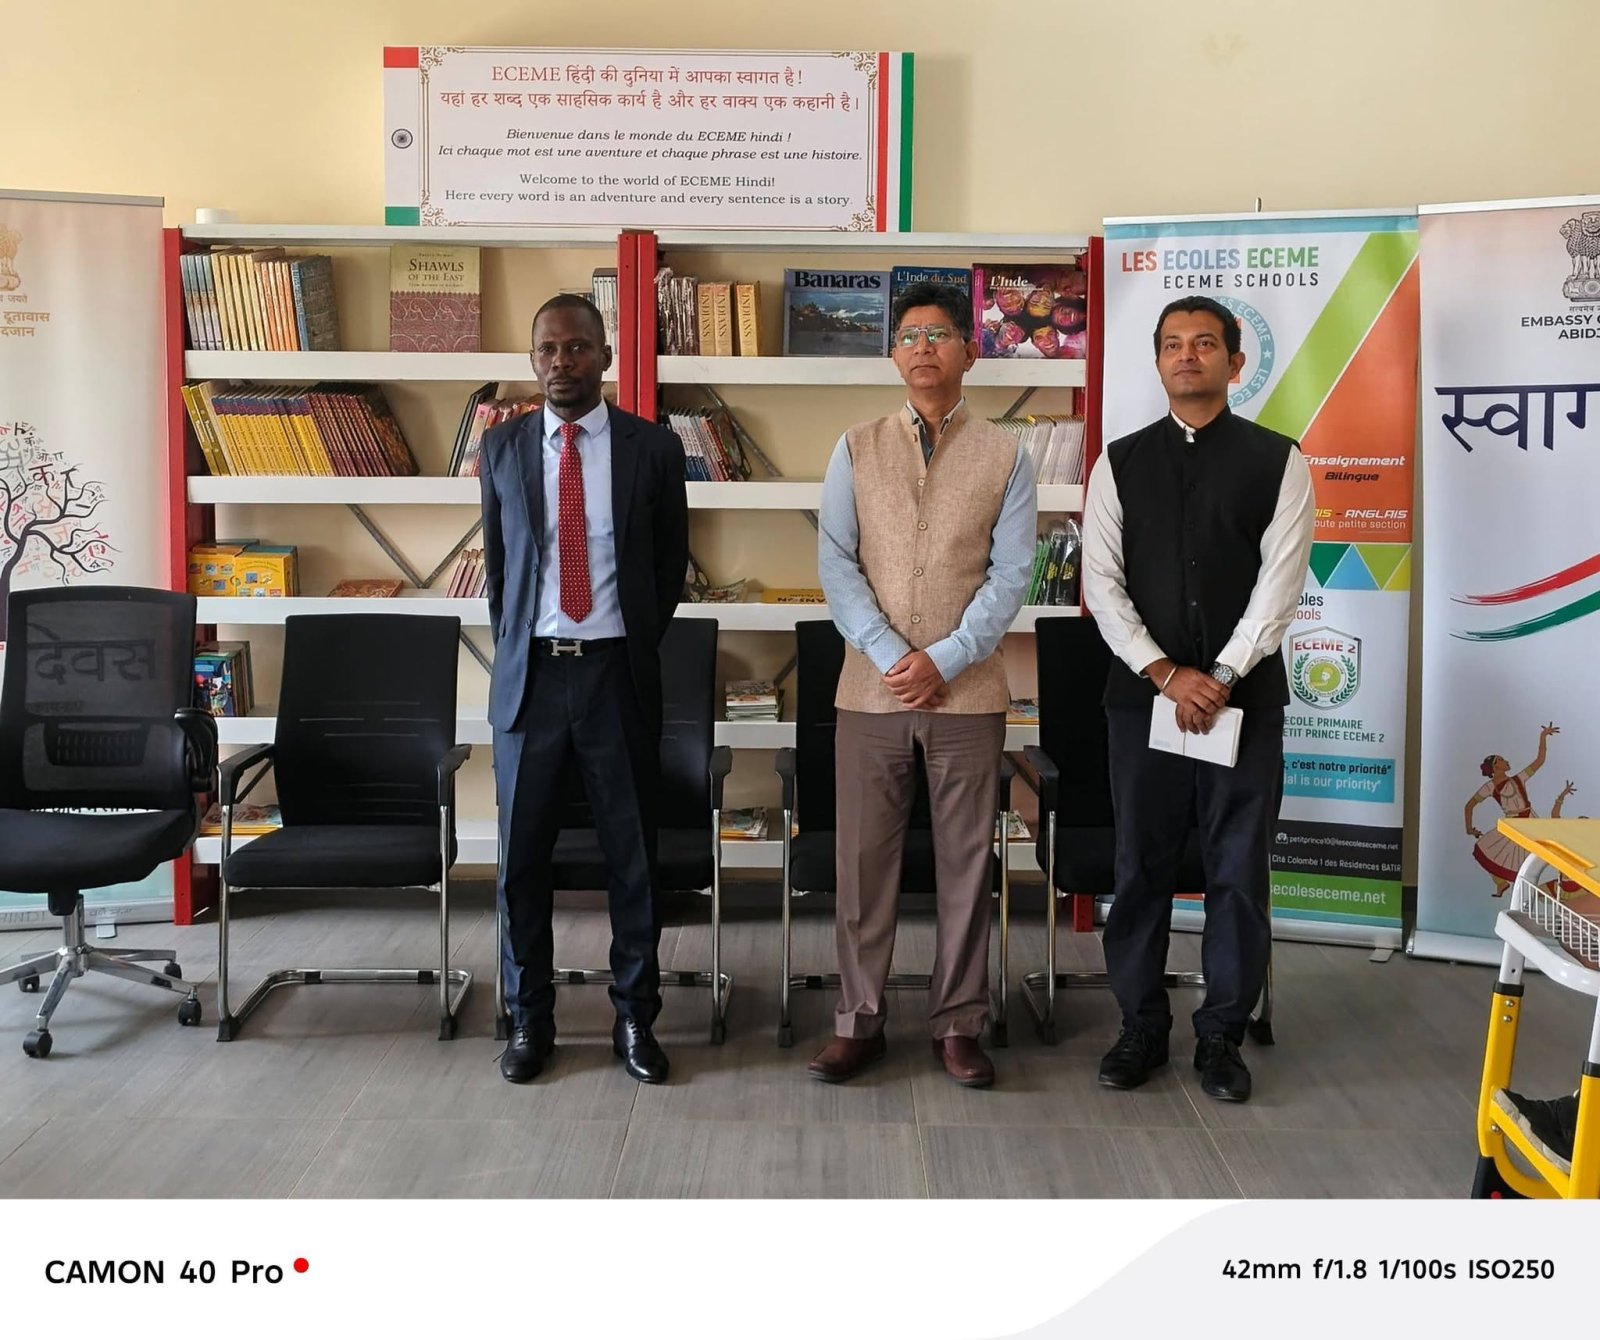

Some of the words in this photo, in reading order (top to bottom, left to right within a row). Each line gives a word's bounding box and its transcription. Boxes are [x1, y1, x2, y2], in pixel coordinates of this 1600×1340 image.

[492, 67, 561, 81] ECEME
[567, 65, 596, 84] हिंदी
[600, 65, 618, 82] की
[623, 65, 664, 87] दुनिया
[669, 66, 679, 83] में
[686, 70, 733, 84] आपका
[737, 71, 780, 84] स्वागत
[471, 93, 488, 107] हर
[494, 93, 523, 108] शब्द
[528, 93, 550, 108] एक
[557, 90, 612, 109] साहसिक
[618, 90, 646, 107] कार्य
[653, 89, 662, 110] है
[668, 90, 694, 109] और
[700, 96, 717, 110] हर
[723, 96, 757, 109] वाक्य
[764, 97, 787, 111] एक
[793, 93, 835, 111] कहानी
[506, 129, 574, 140] Bienvenue
[578, 130, 610, 140] dans
[615, 130, 625, 141] le
[629, 131, 673, 141] monde
[677, 131, 693, 141] du
[698, 132, 746, 142] ECEME
[439, 146, 453, 156] Ici
[457, 146, 503, 158] chaque
[507, 147, 530, 156] mot
[535, 148, 553, 157] est
[558, 149, 582, 157] une
[585, 149, 642, 158] aventure
[646, 149, 657, 158] et
[662, 148, 708, 161] chaque
[712, 149, 756, 161] phrase
[760, 150, 779, 160] est
[784, 151, 808, 160] une
[812, 150, 862, 160] histoire.
[520, 174, 577, 185] Welcome
[582, 176, 594, 185] to
[599, 175, 620, 185] the
[624, 175, 659, 186] world
[664, 176, 677, 186] of
[681, 177, 731, 187] ECEME
[736, 177, 775, 187] Hindi!
[446, 190, 475, 201] Here
[480, 193, 514, 203] every
[518, 192, 549, 201] word
[555, 192, 565, 202] is
[570, 194, 586, 202] an
[591, 192, 656, 202] adventure
[661, 193, 685, 204] and
[690, 195, 724, 206] every
[728, 194, 786, 204] sentence
[790, 195, 800, 204] is
[805, 196, 813, 204] a
[409, 258, 464, 272] SHAWLS
[1121, 251, 1157, 272] LES
[1164, 249, 1240, 270] ECOLES
[1247, 246, 1319, 269] ECEME
[444, 273, 464, 281] EAST
[794, 272, 881, 288] Banaras
[897, 271, 928, 282] L'Inde
[931, 274, 944, 283] du
[948, 274, 967, 283] Sud
[990, 276, 1028, 287] L'Inde
[1164, 275, 1224, 289] ECEME
[1235, 273, 1319, 287] SCHOOLS
[1236, 303, 1271, 342] ECEME
[1521, 314, 1593, 327] EMBASSY
[1250, 368, 1269, 390] LES
[1325, 471, 1380, 482] Bilingue
[1345, 510, 1408, 518] ANGLAIS
[1339, 520, 1367, 529] petite
[1370, 520, 1406, 529] section
[1294, 638, 1344, 652] ECEME
[1348, 644, 1356, 654] 2
[1317, 718, 1363, 730] PRIMAIRE
[1306, 729, 1340, 740] PRINCE
[1344, 731, 1376, 742] ECEME
[1379, 734, 1385, 743] 2
[1292, 760, 1316, 771] c'est
[1318, 762, 1346, 772] notre
[1300, 775, 1310, 785] is
[1314, 777, 1331, 787] our
[1287, 856, 1318, 866] Colombe
